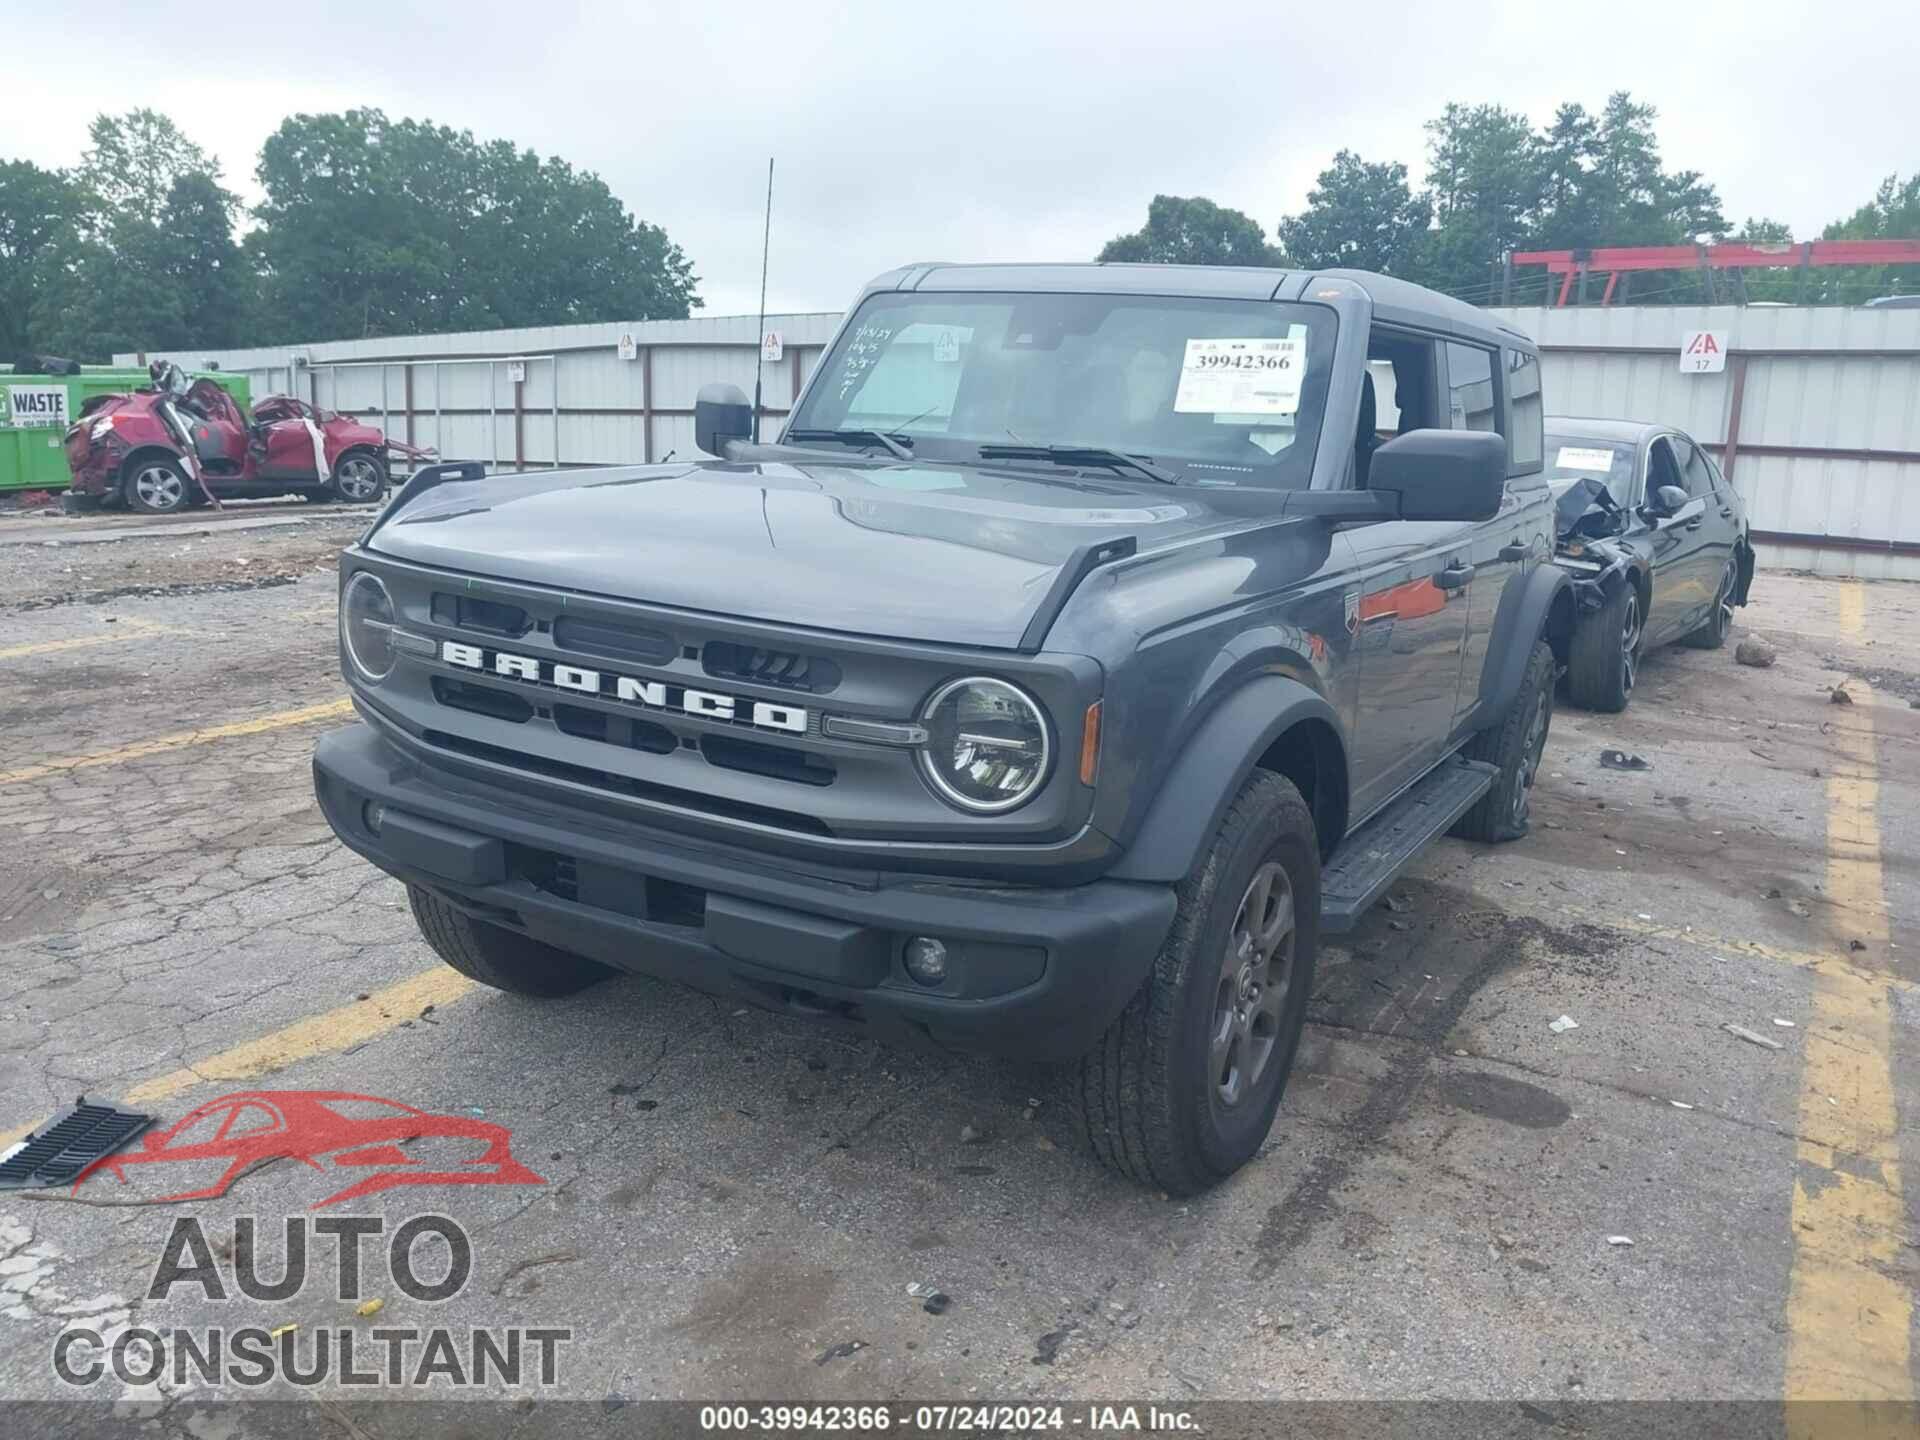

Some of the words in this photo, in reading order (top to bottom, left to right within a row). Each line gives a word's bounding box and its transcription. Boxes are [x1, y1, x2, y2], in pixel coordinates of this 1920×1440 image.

[1687, 333, 1718, 353] IAA
[1195, 355, 1290, 369] 39942366
[1695, 360, 1710, 370] 17
[13, 393, 63, 412] WASTE
[442, 641, 808, 733] BRONCO
